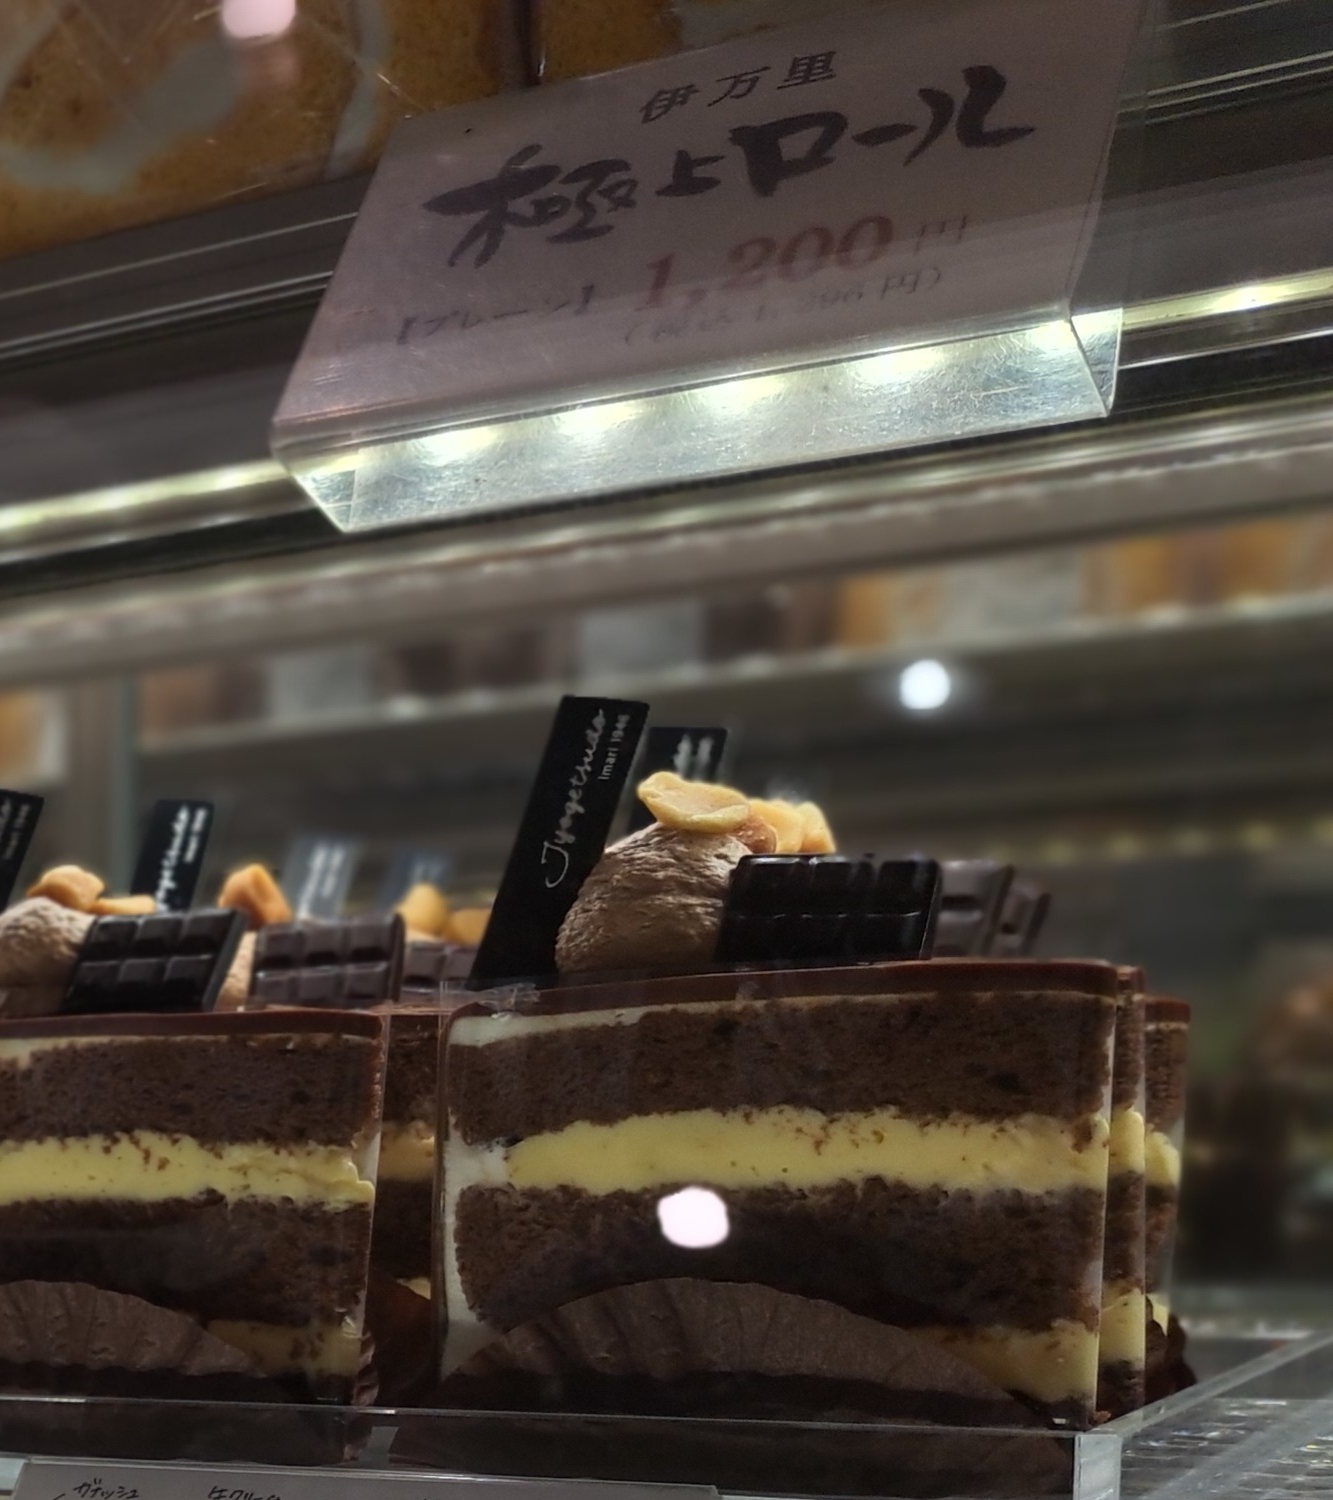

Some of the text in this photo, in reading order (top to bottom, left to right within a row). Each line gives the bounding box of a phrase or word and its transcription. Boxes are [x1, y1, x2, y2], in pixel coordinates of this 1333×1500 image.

[639, 51, 837, 124] 伊万里
[422, 65, 1036, 268] 極上ロール
[73, 1478, 139, 1500] ガナッシュ
